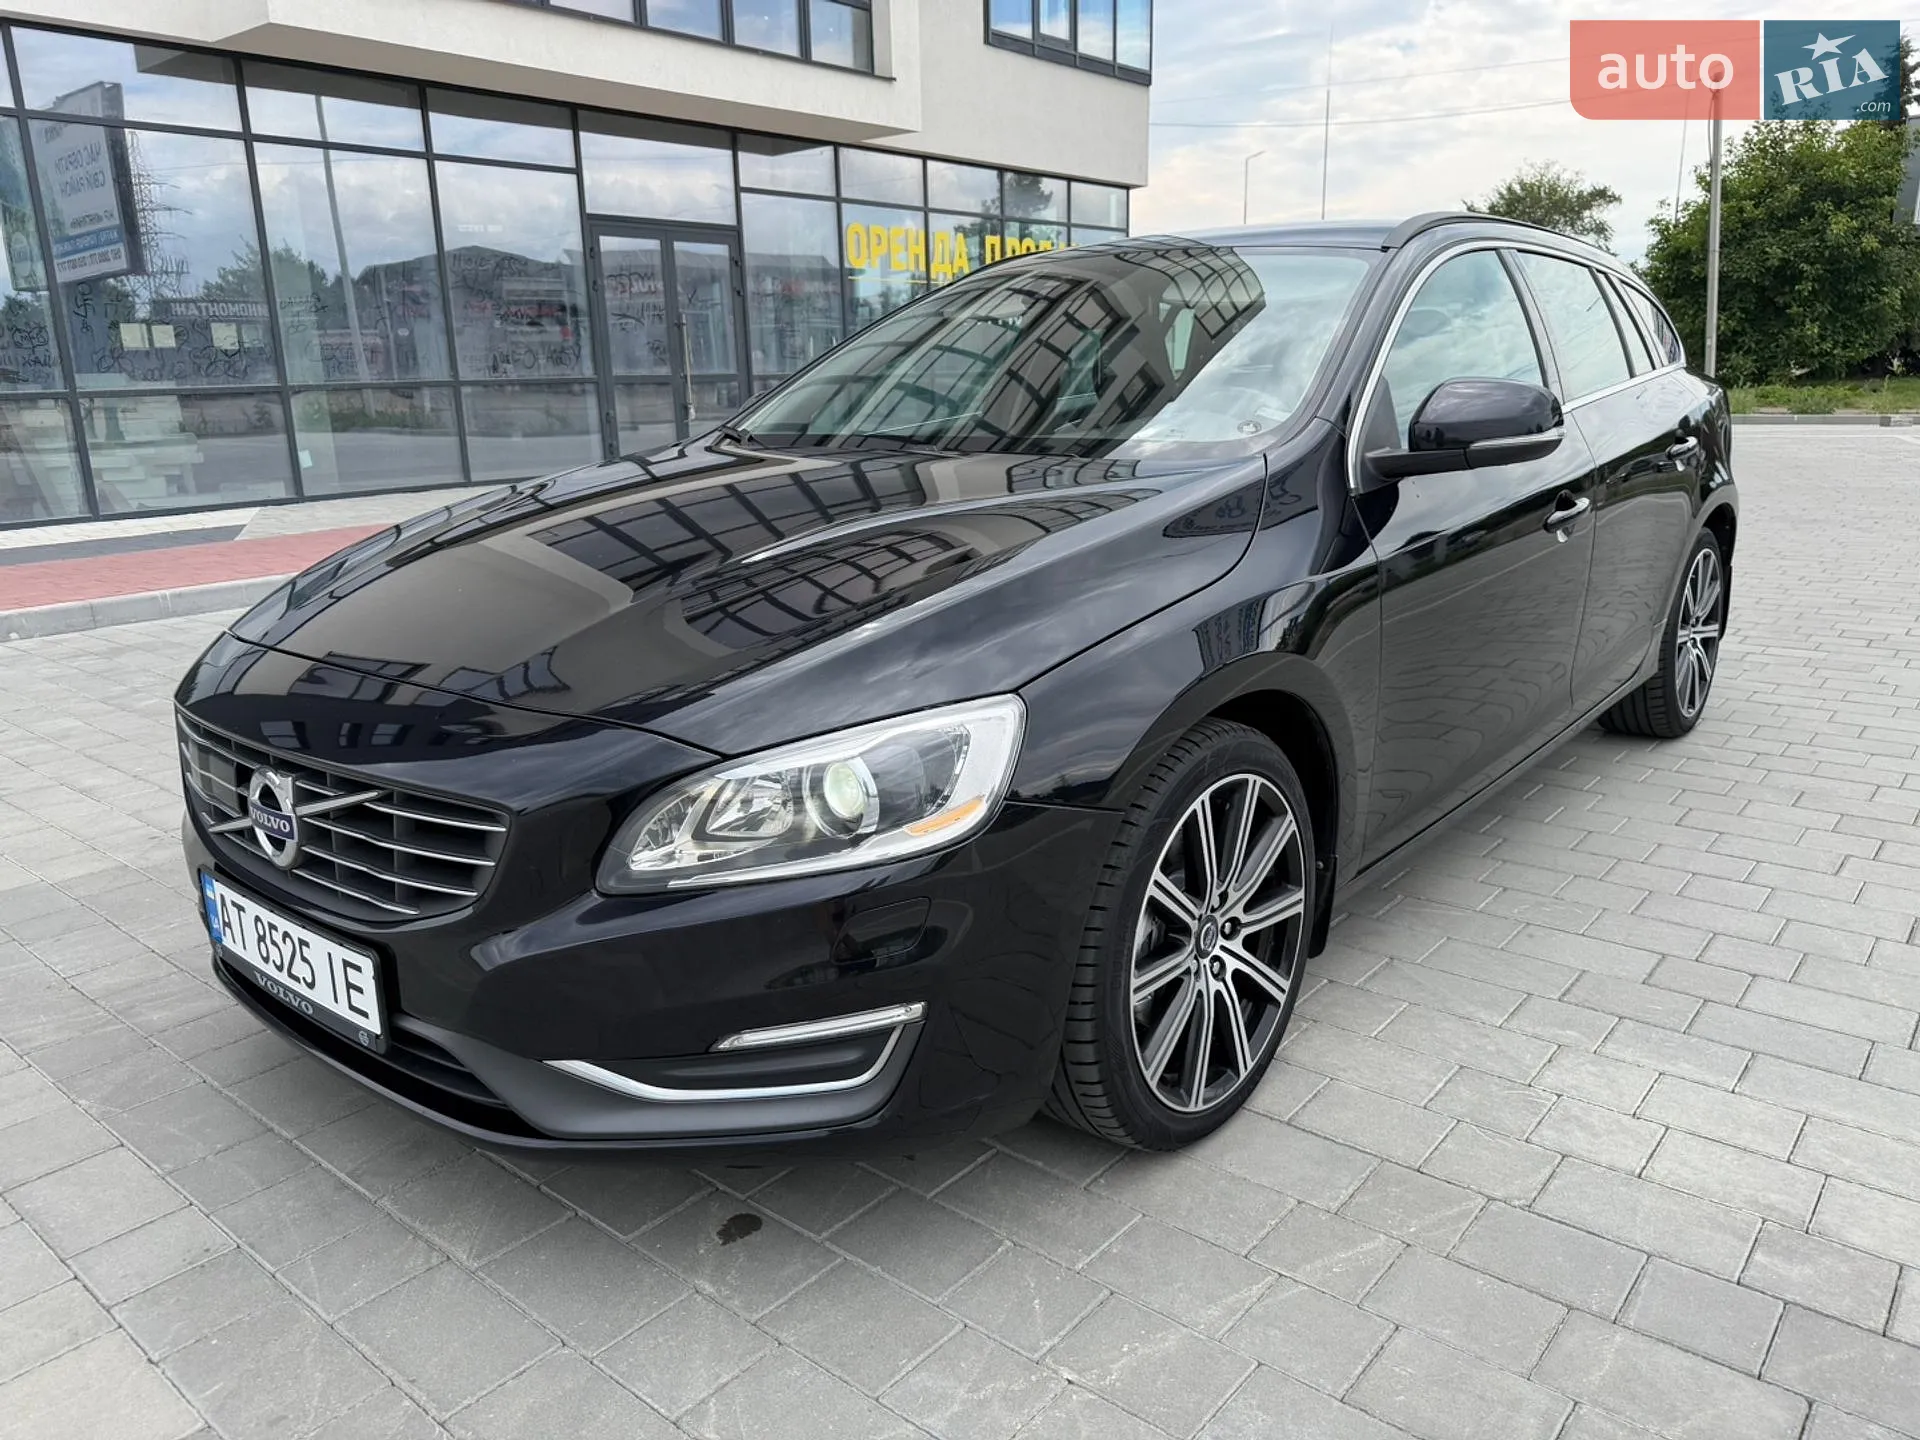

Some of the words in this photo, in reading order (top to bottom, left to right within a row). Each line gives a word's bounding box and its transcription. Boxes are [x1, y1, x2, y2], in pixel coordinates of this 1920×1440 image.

[846, 220, 971, 281] ОРЕНДА
[249, 805, 291, 833] VOLVO
[219, 893, 247, 951] AT
[254, 914, 316, 991] 8525
[327, 951, 370, 1021] IE
[254, 970, 314, 1015] VOLVO
